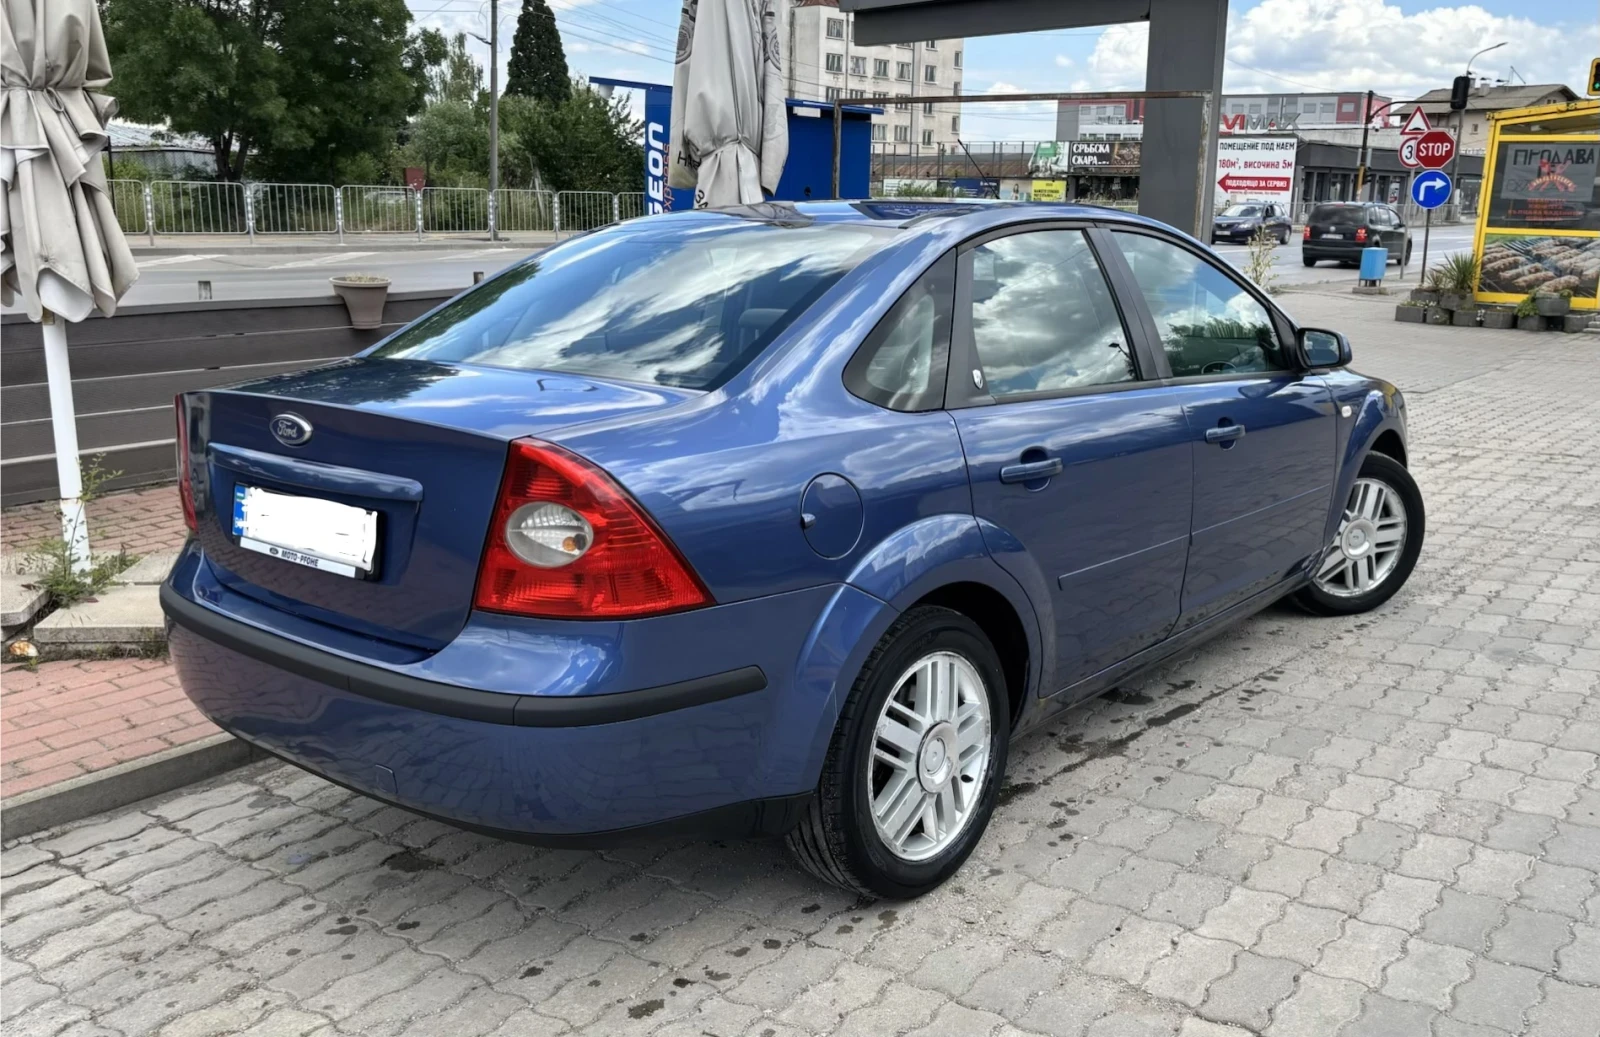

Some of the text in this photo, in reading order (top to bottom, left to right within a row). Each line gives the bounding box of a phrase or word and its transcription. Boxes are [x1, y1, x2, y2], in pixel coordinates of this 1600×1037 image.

[1222, 113, 1301, 130] VIMAX
[1220, 142, 1295, 152] ПОМЕЩЕНИЕ ПОД НАЕМ
[1419, 142, 1451, 156] STOP
[1072, 156, 1098, 164] СКАРА
[1244, 160, 1280, 169] височина
[1282, 160, 1292, 168] 5м
[664, 143, 675, 214] xpress
[276, 420, 298, 438] Ford
